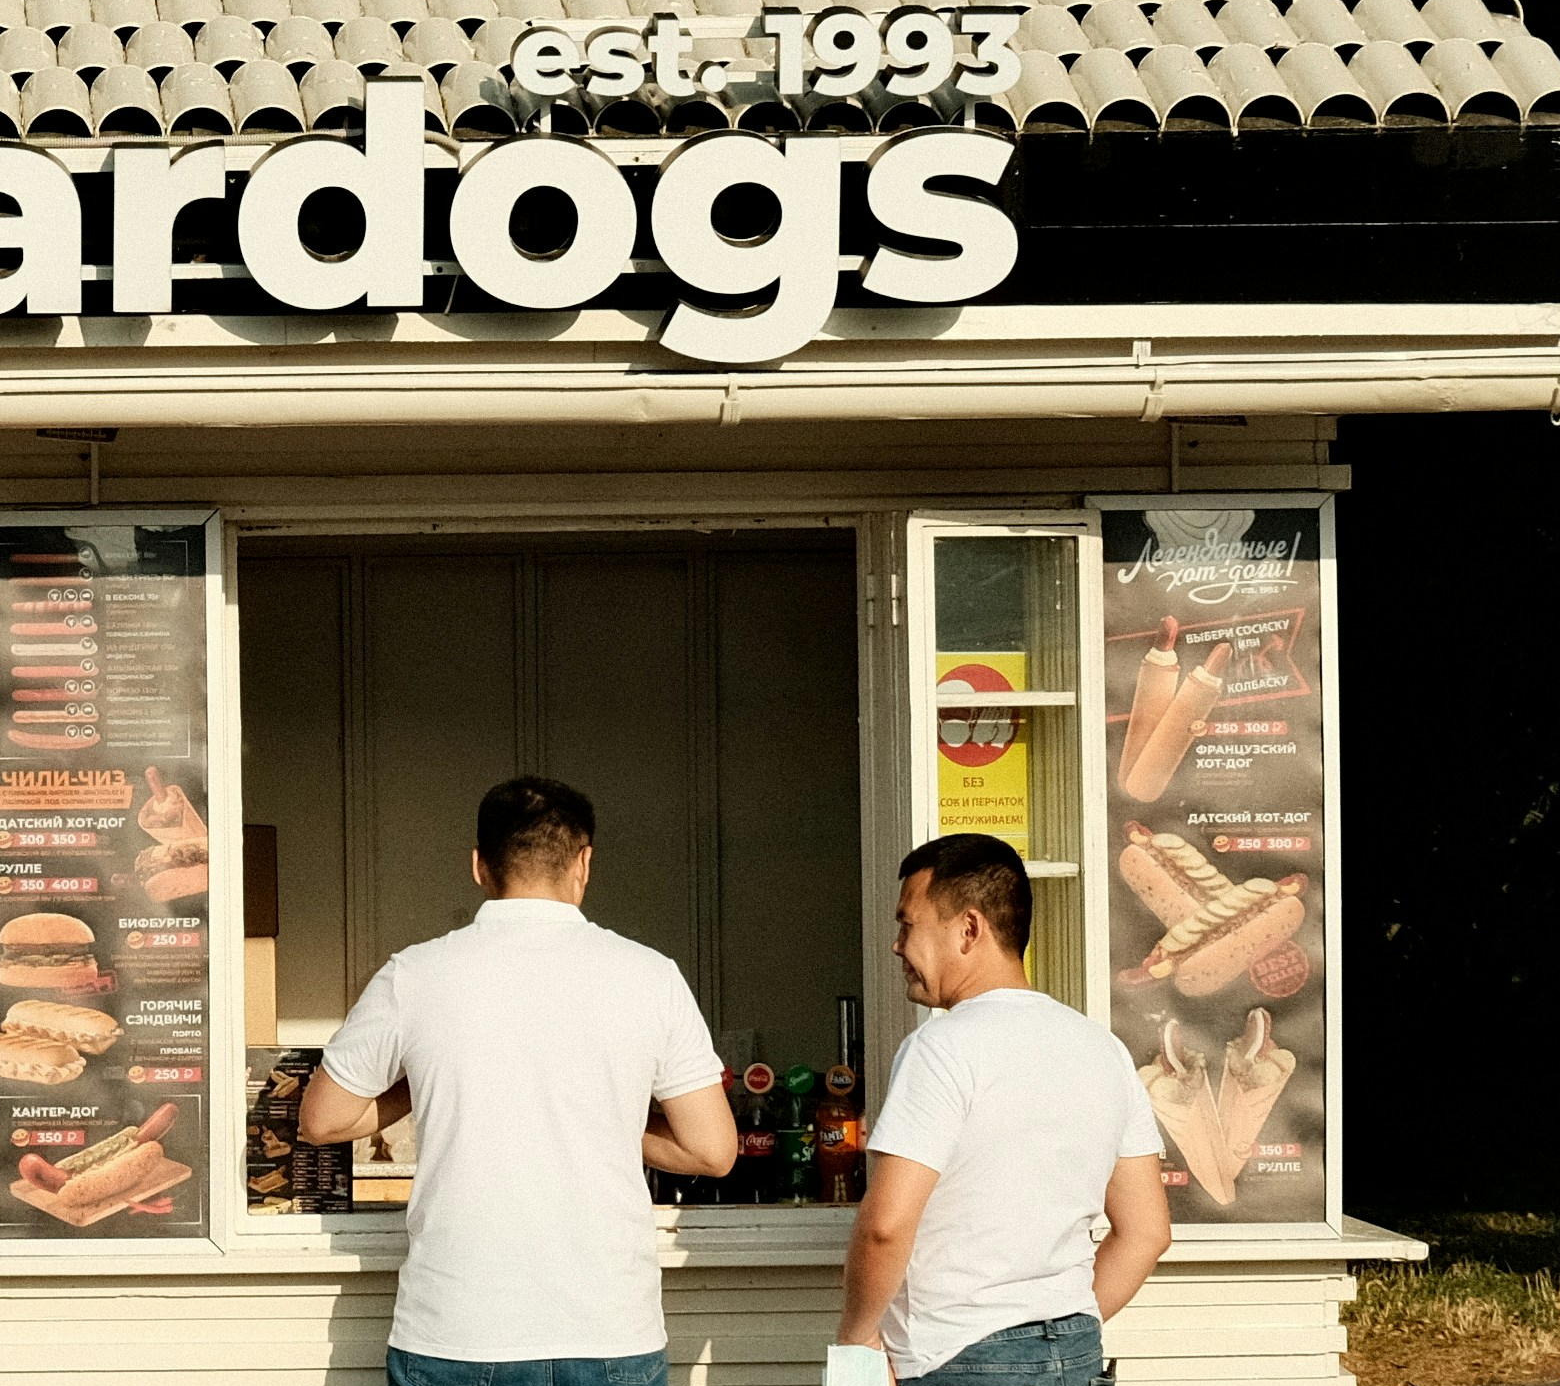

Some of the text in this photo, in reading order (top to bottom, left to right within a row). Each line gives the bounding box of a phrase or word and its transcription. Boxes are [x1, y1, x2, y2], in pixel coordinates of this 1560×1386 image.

[510, 6, 1023, 98] est. 1993
[1117, 527, 1288, 584] Легендарные
[1185, 619, 1290, 644] ВЫБЕРИ СОСИСКУ
[1227, 676, 1290, 693] КОЛБАСКУ
[1195, 742, 1297, 757] ФРАНЦУЗСКИЙ
[1195, 758, 1254, 770] ХОТ-ДОГ
[1, 770, 126, 787] ЧИЛИ-ЧИЗ
[963, 777, 984, 788] БЕЗ
[962, 797, 970, 807] И
[972, 797, 1024, 807] ПЕРЧАТОК
[67, 817, 126, 830] ХОТ-ДОГ
[1187, 811, 1313, 825] ДАТСКИЙ ХОТ-ДОГ
[19, 834, 76, 845] 300 350
[20, 880, 80, 891] 350 400
[118, 917, 201, 929] БИФБУРГЕР
[152, 934, 178, 946] 250
[140, 1001, 203, 1013] ГОРЯЧИЕ
[125, 1015, 202, 1027] СЭНДВИЧИ
[153, 1069, 179, 1080] 250
[11, 1105, 99, 1119] ХАНТЕР-ДОГ
[36, 1132, 63, 1143] 350
[1259, 1144, 1283, 1156] 350
